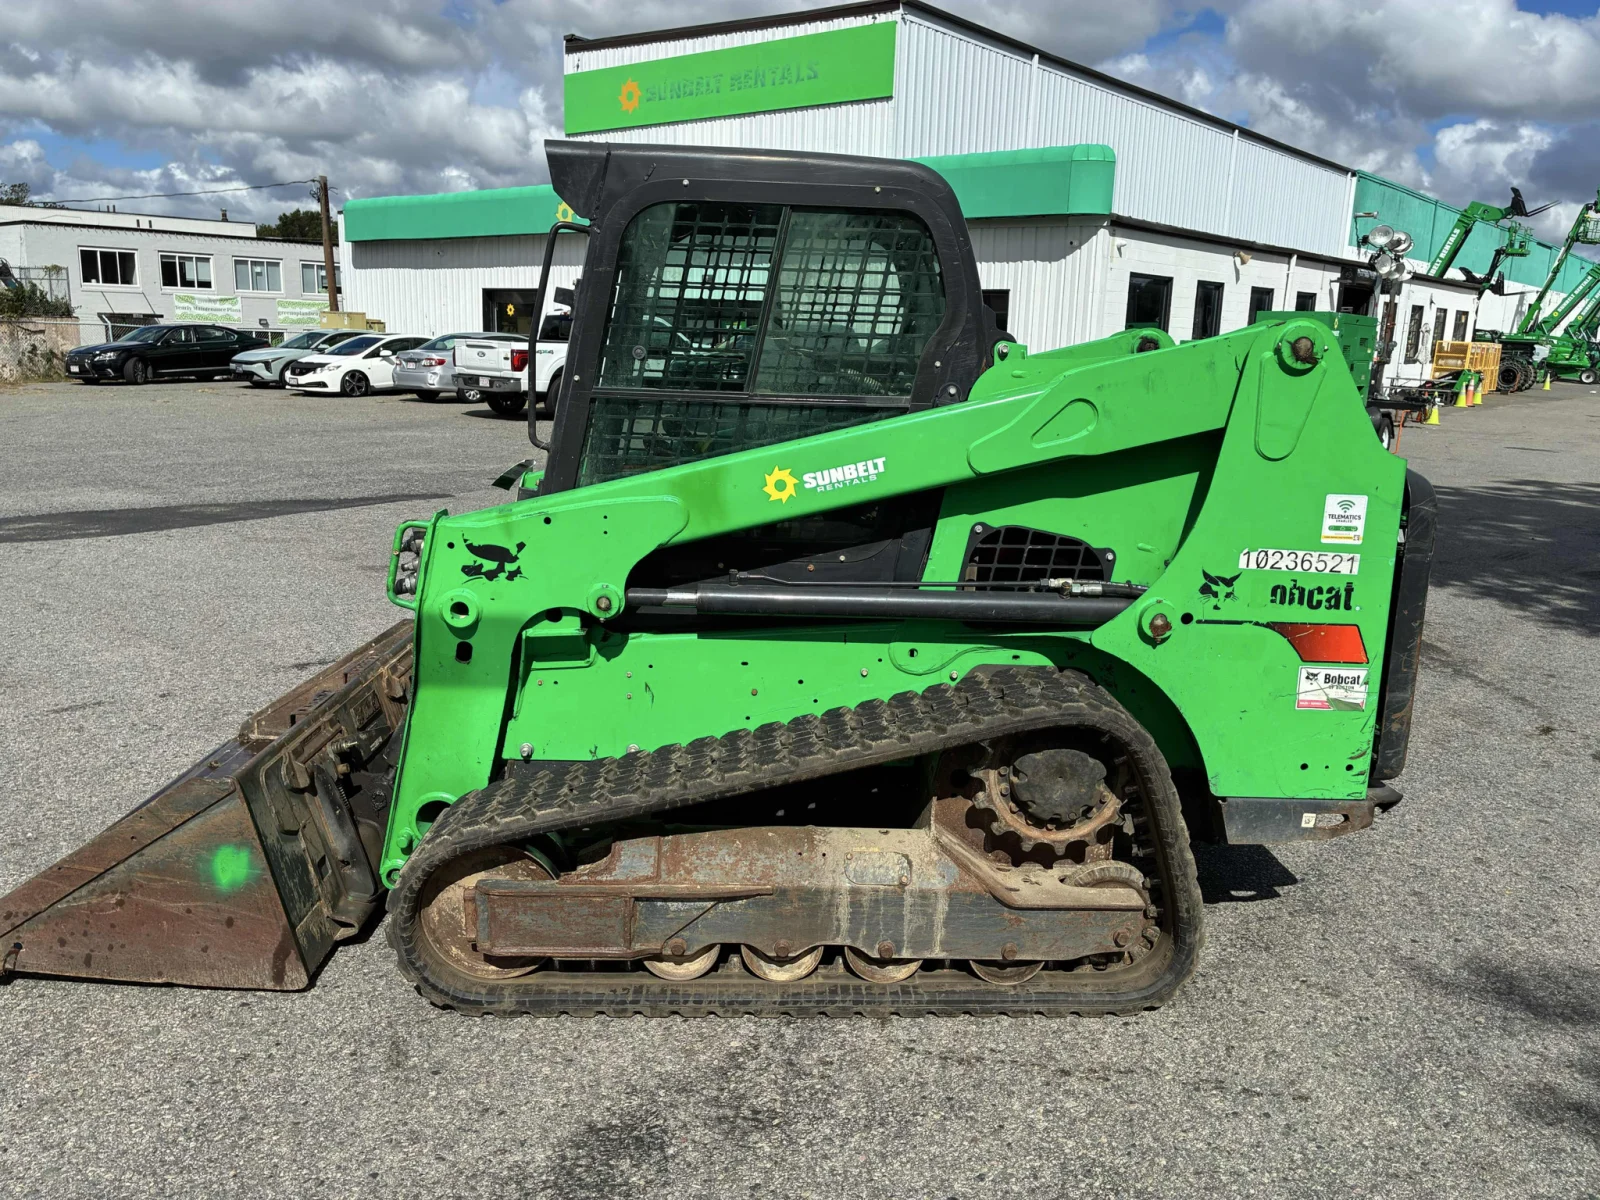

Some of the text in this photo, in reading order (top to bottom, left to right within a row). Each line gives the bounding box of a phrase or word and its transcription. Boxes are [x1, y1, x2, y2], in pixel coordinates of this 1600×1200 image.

[646, 61, 820, 102] SUNBELT RENTALS
[1439, 228, 1461, 259] RENTALS
[802, 457, 887, 489] SUNBELT
[816, 474, 878, 493] RENTALS
[1327, 513, 1362, 521] TELEMATICS
[1242, 549, 1356, 574] 10236521
[1323, 673, 1361, 686] Bobcat
